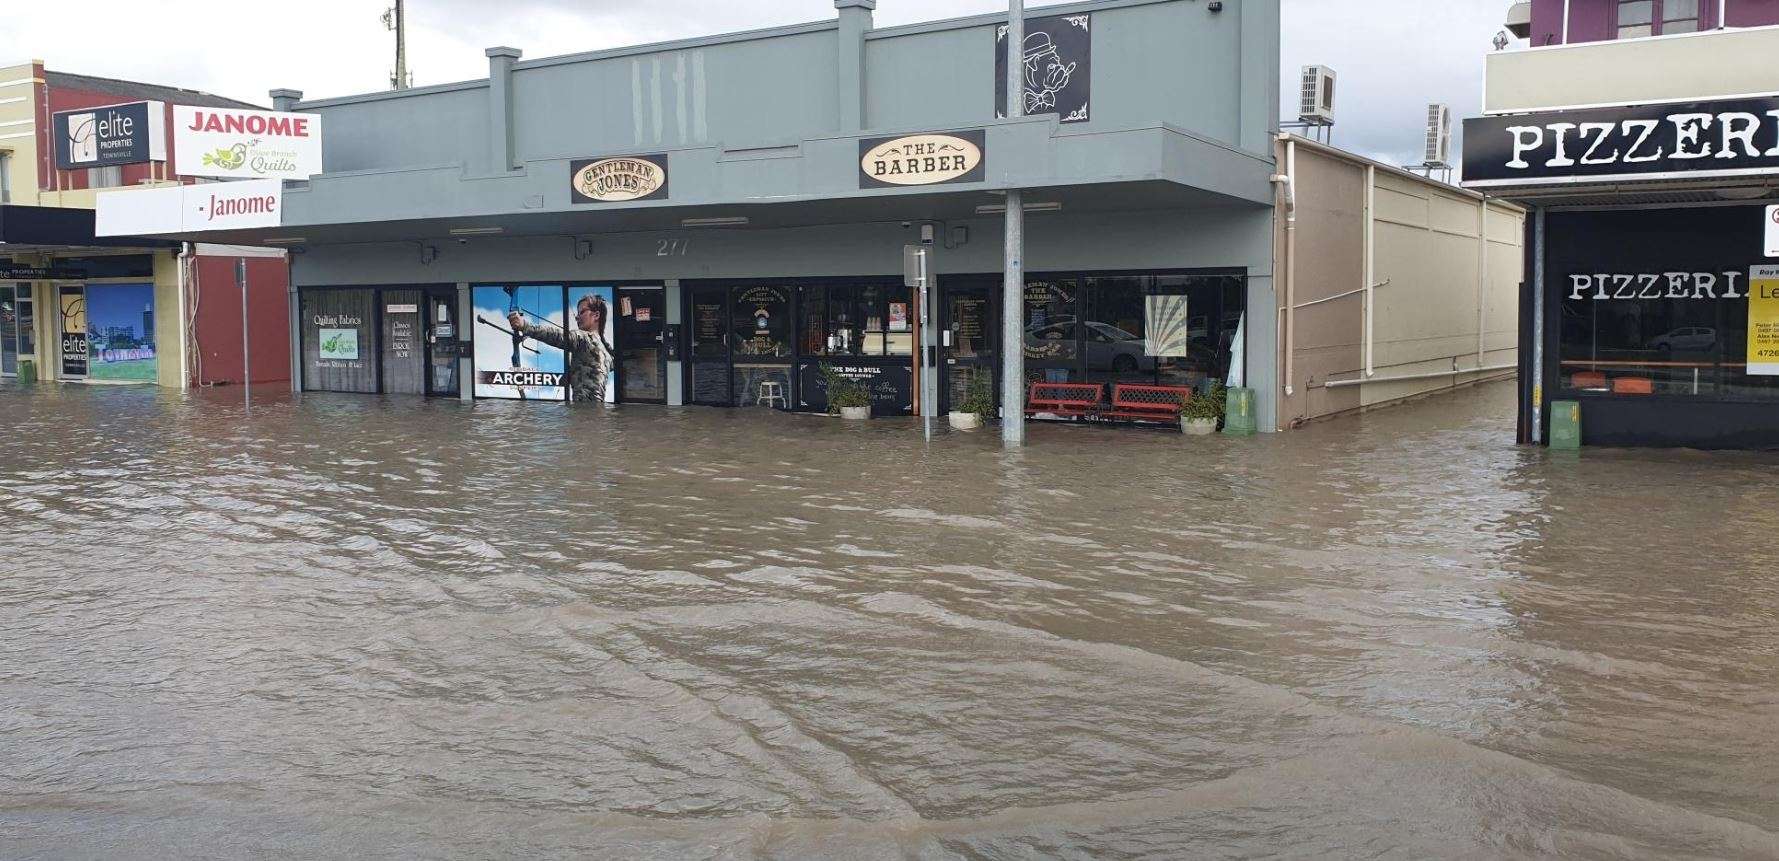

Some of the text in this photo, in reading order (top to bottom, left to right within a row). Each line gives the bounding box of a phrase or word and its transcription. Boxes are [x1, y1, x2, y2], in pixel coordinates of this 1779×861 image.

[98, 109, 133, 138] elite
[188, 111, 309, 137] JANOME
[100, 138, 133, 150] PROPERTIES
[903, 143, 936, 156] THE
[250, 156, 297, 173] Quilts
[585, 161, 652, 181] GENTLEMAN
[874, 155, 966, 176] BARBER
[599, 174, 639, 191] JONES
[208, 194, 275, 221] Janome
[1568, 271, 1750, 300] PIZZERI
[62, 334, 87, 353] elite
[492, 372, 563, 386] ARCHERY
[863, 366, 881, 374] BULL
